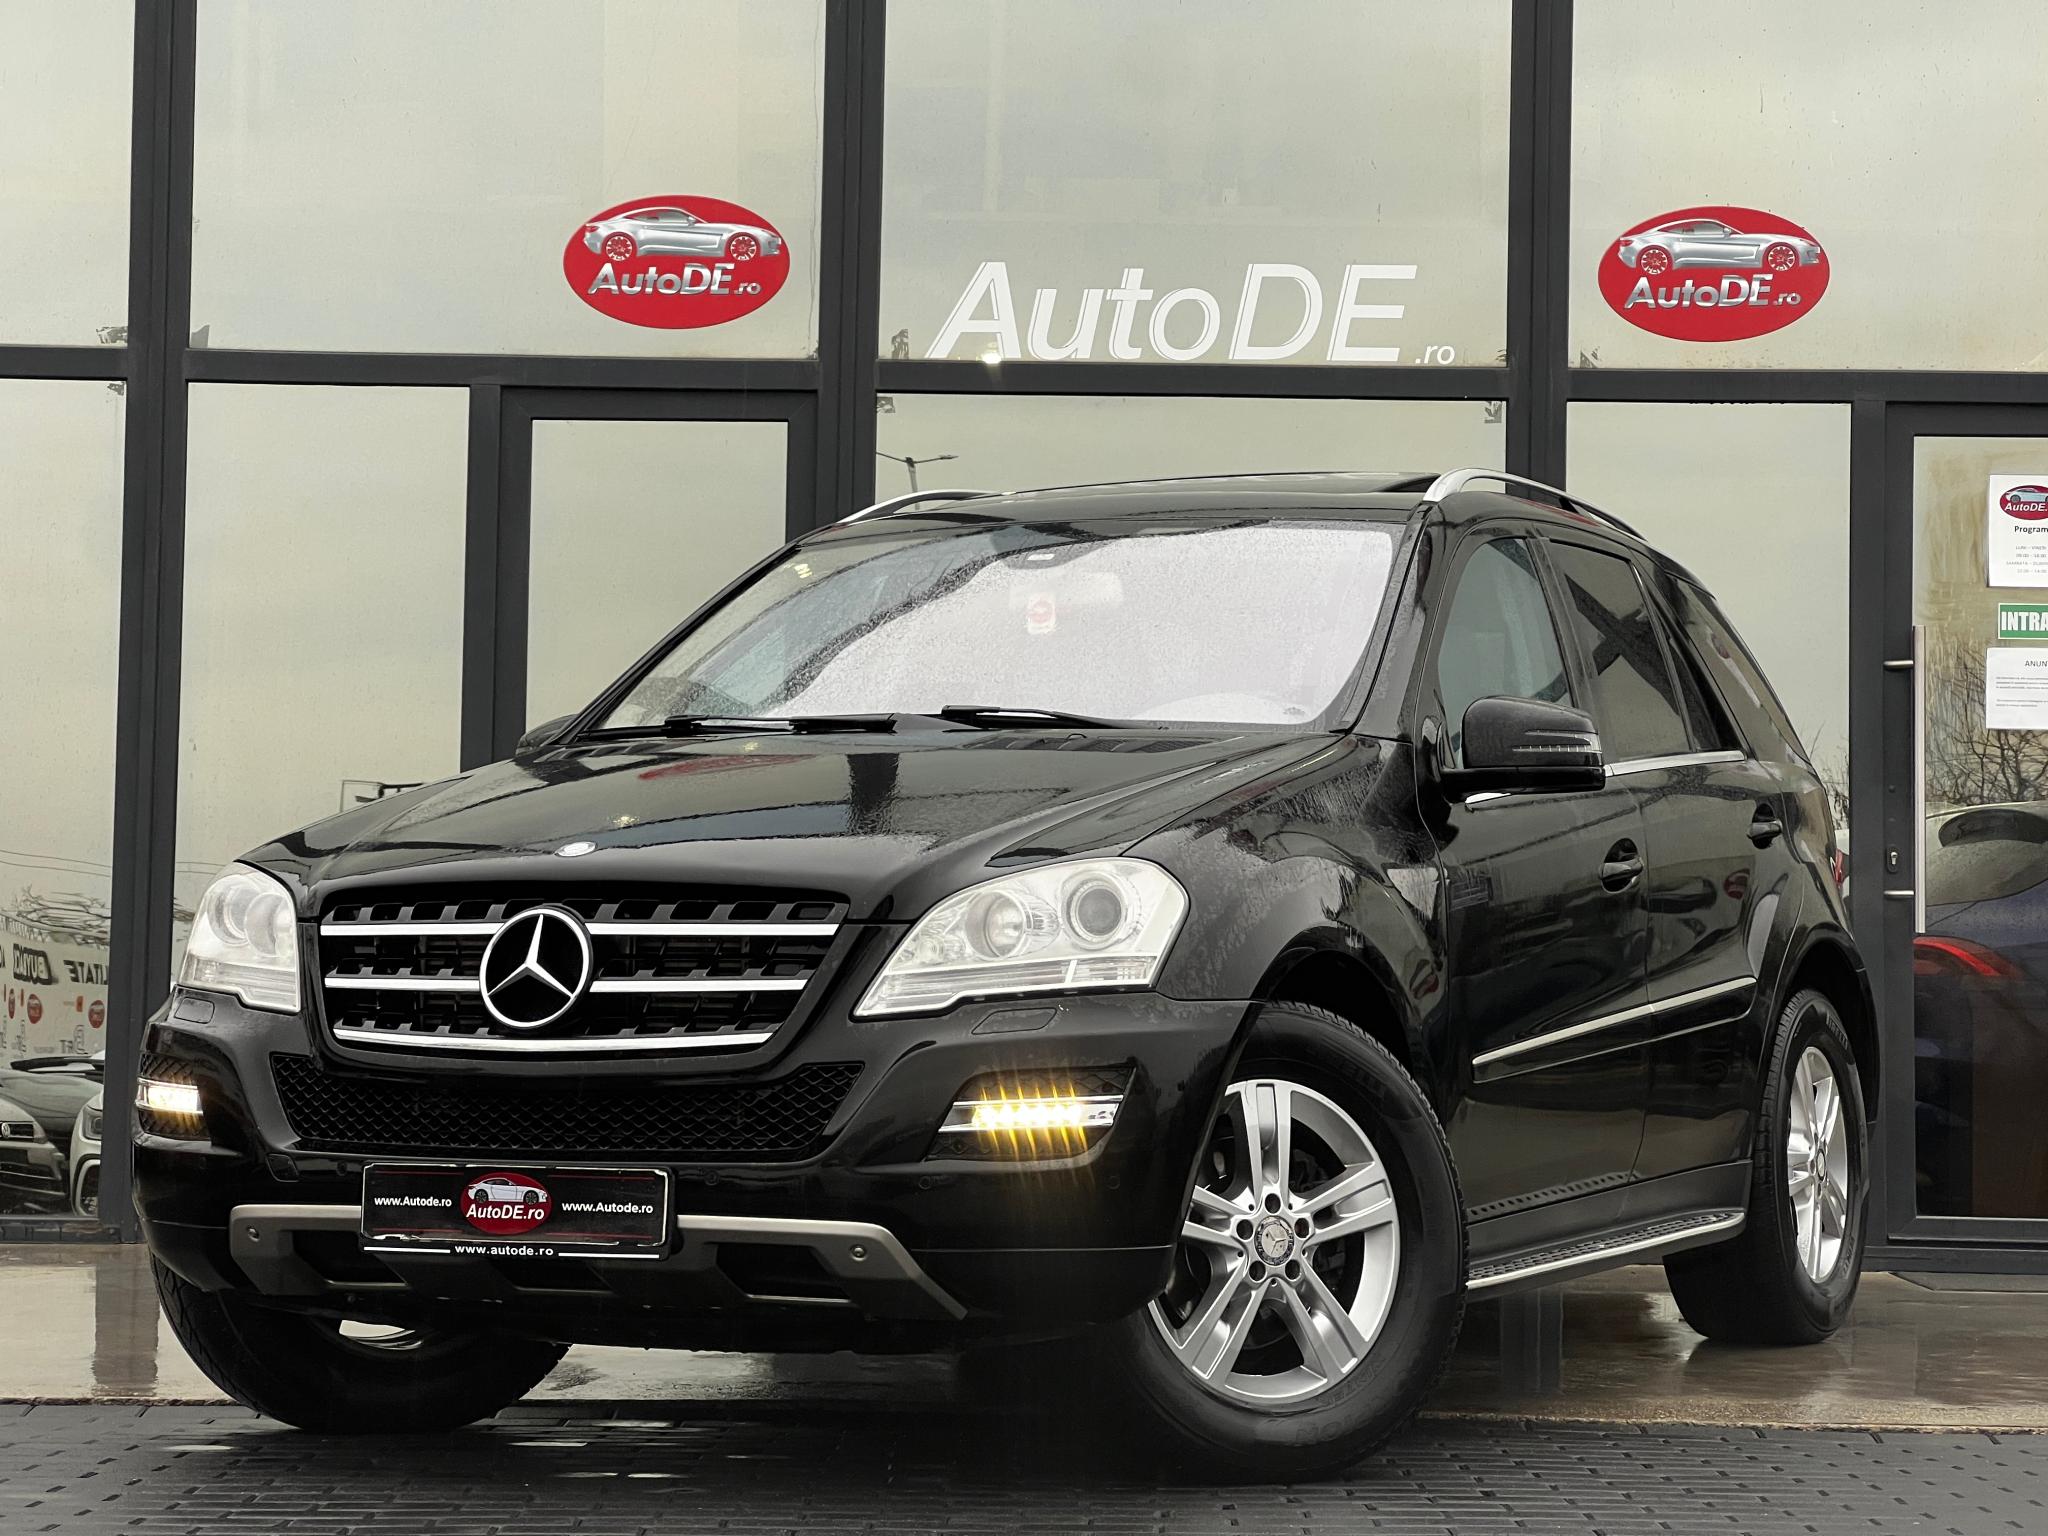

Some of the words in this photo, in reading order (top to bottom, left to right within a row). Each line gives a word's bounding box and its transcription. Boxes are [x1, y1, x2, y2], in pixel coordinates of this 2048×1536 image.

[2024, 660, 2048, 668] ANUN
[374, 1195, 452, 1208] www.Autode.ro
[562, 1201, 654, 1215] www.Autode.ro
[466, 1203, 545, 1221] AutoDE.ro
[454, 1244, 554, 1257] www.autode.ro
